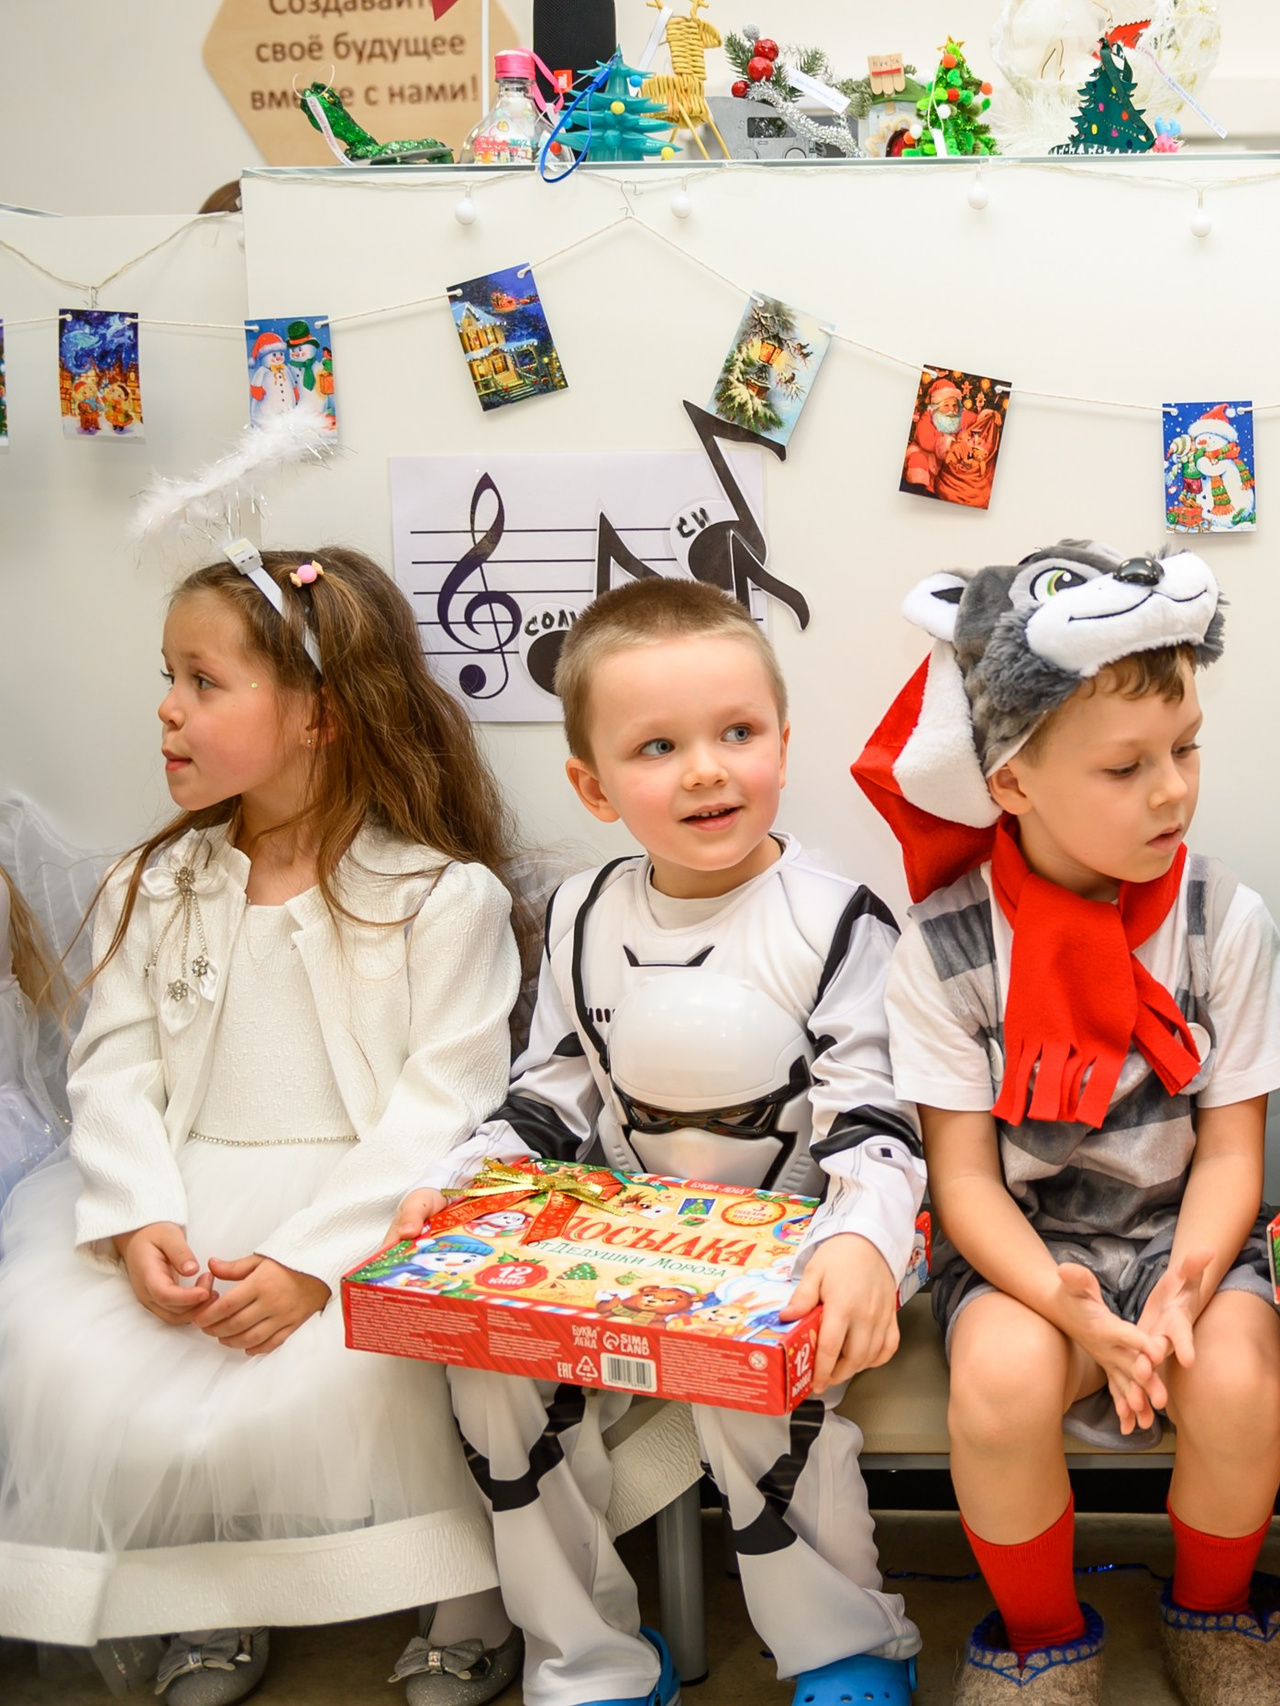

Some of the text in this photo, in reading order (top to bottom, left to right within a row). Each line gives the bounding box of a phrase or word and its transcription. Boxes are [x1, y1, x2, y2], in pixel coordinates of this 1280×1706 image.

[268, 0, 432, 18] Создава
[255, 32, 467, 65] своё будущее
[251, 74, 480, 111] вме с нами!
[499, 1265, 534, 1280] 12
[620, 1333, 649, 1348] SIMA
[620, 1343, 650, 1356] LAND
[794, 1342, 811, 1378] 12
